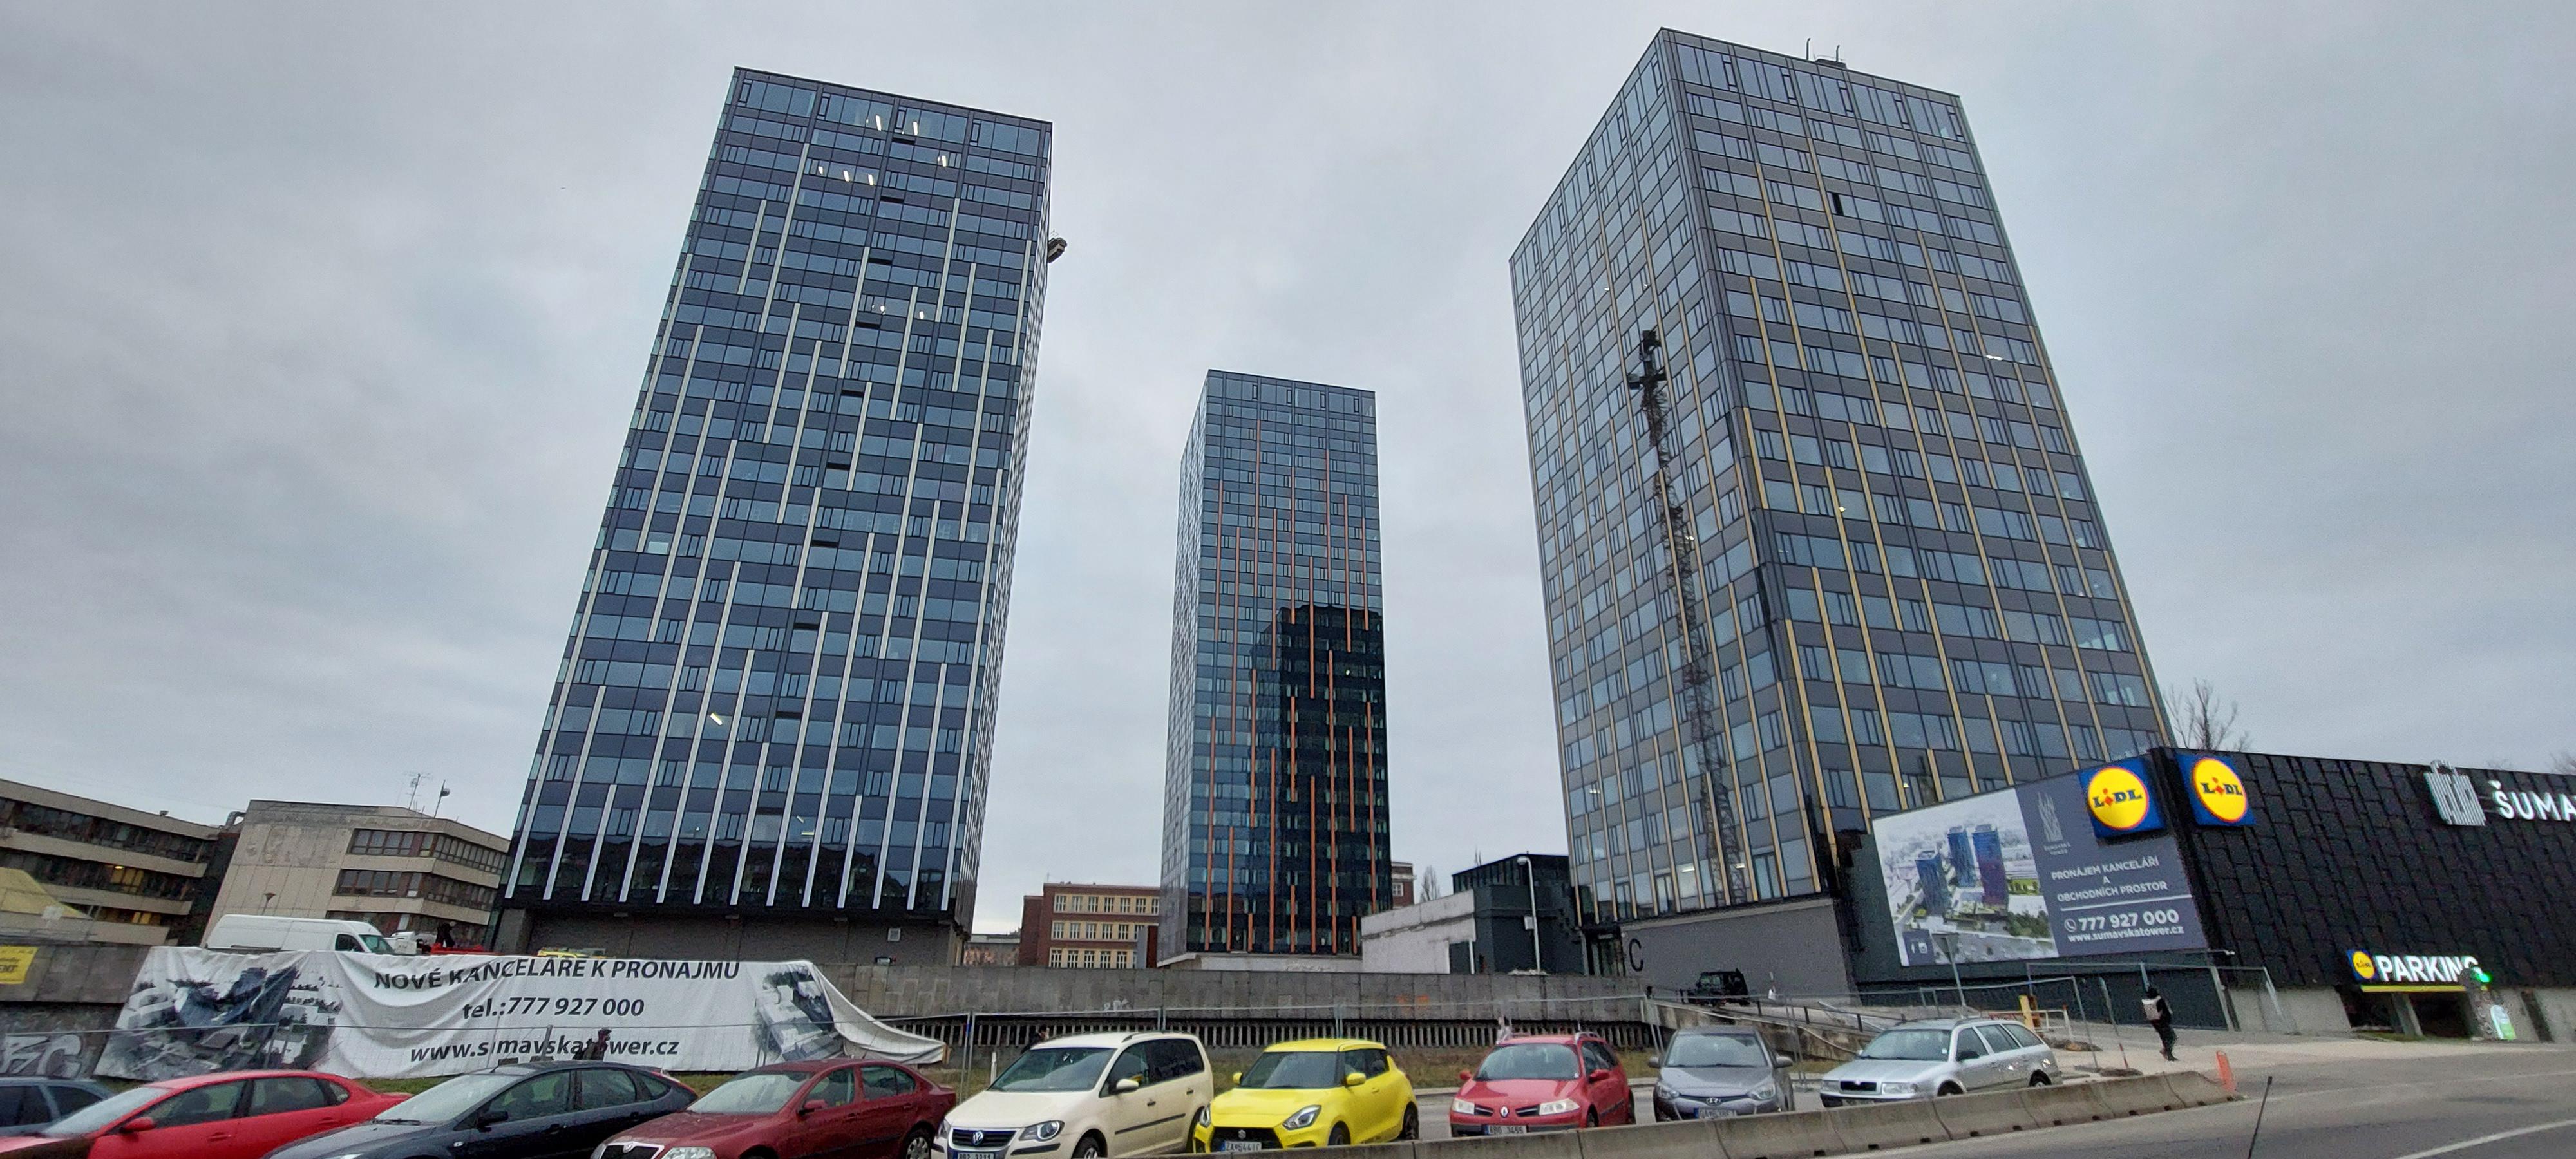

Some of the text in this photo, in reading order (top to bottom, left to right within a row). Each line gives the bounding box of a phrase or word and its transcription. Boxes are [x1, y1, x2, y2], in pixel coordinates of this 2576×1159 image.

[2488, 780, 2576, 821] ŠUMA
[2051, 865, 2101, 880] PRONÁJEM
[2103, 876, 2110, 885] A
[2057, 880, 2168, 902] OBCHODNÍCH PROSTOR
[2078, 909, 2180, 932] 777 927 000
[2067, 925, 2185, 942] www.sumavskatower.cz
[1629, 938, 1644, 972] C
[374, 968, 442, 990] NOVÉ
[591, 960, 608, 978] K
[554, 998, 599, 1015] 927
[602, 999, 645, 1016] 000
[410, 1035, 680, 1062] www.smavskatwer.cz
